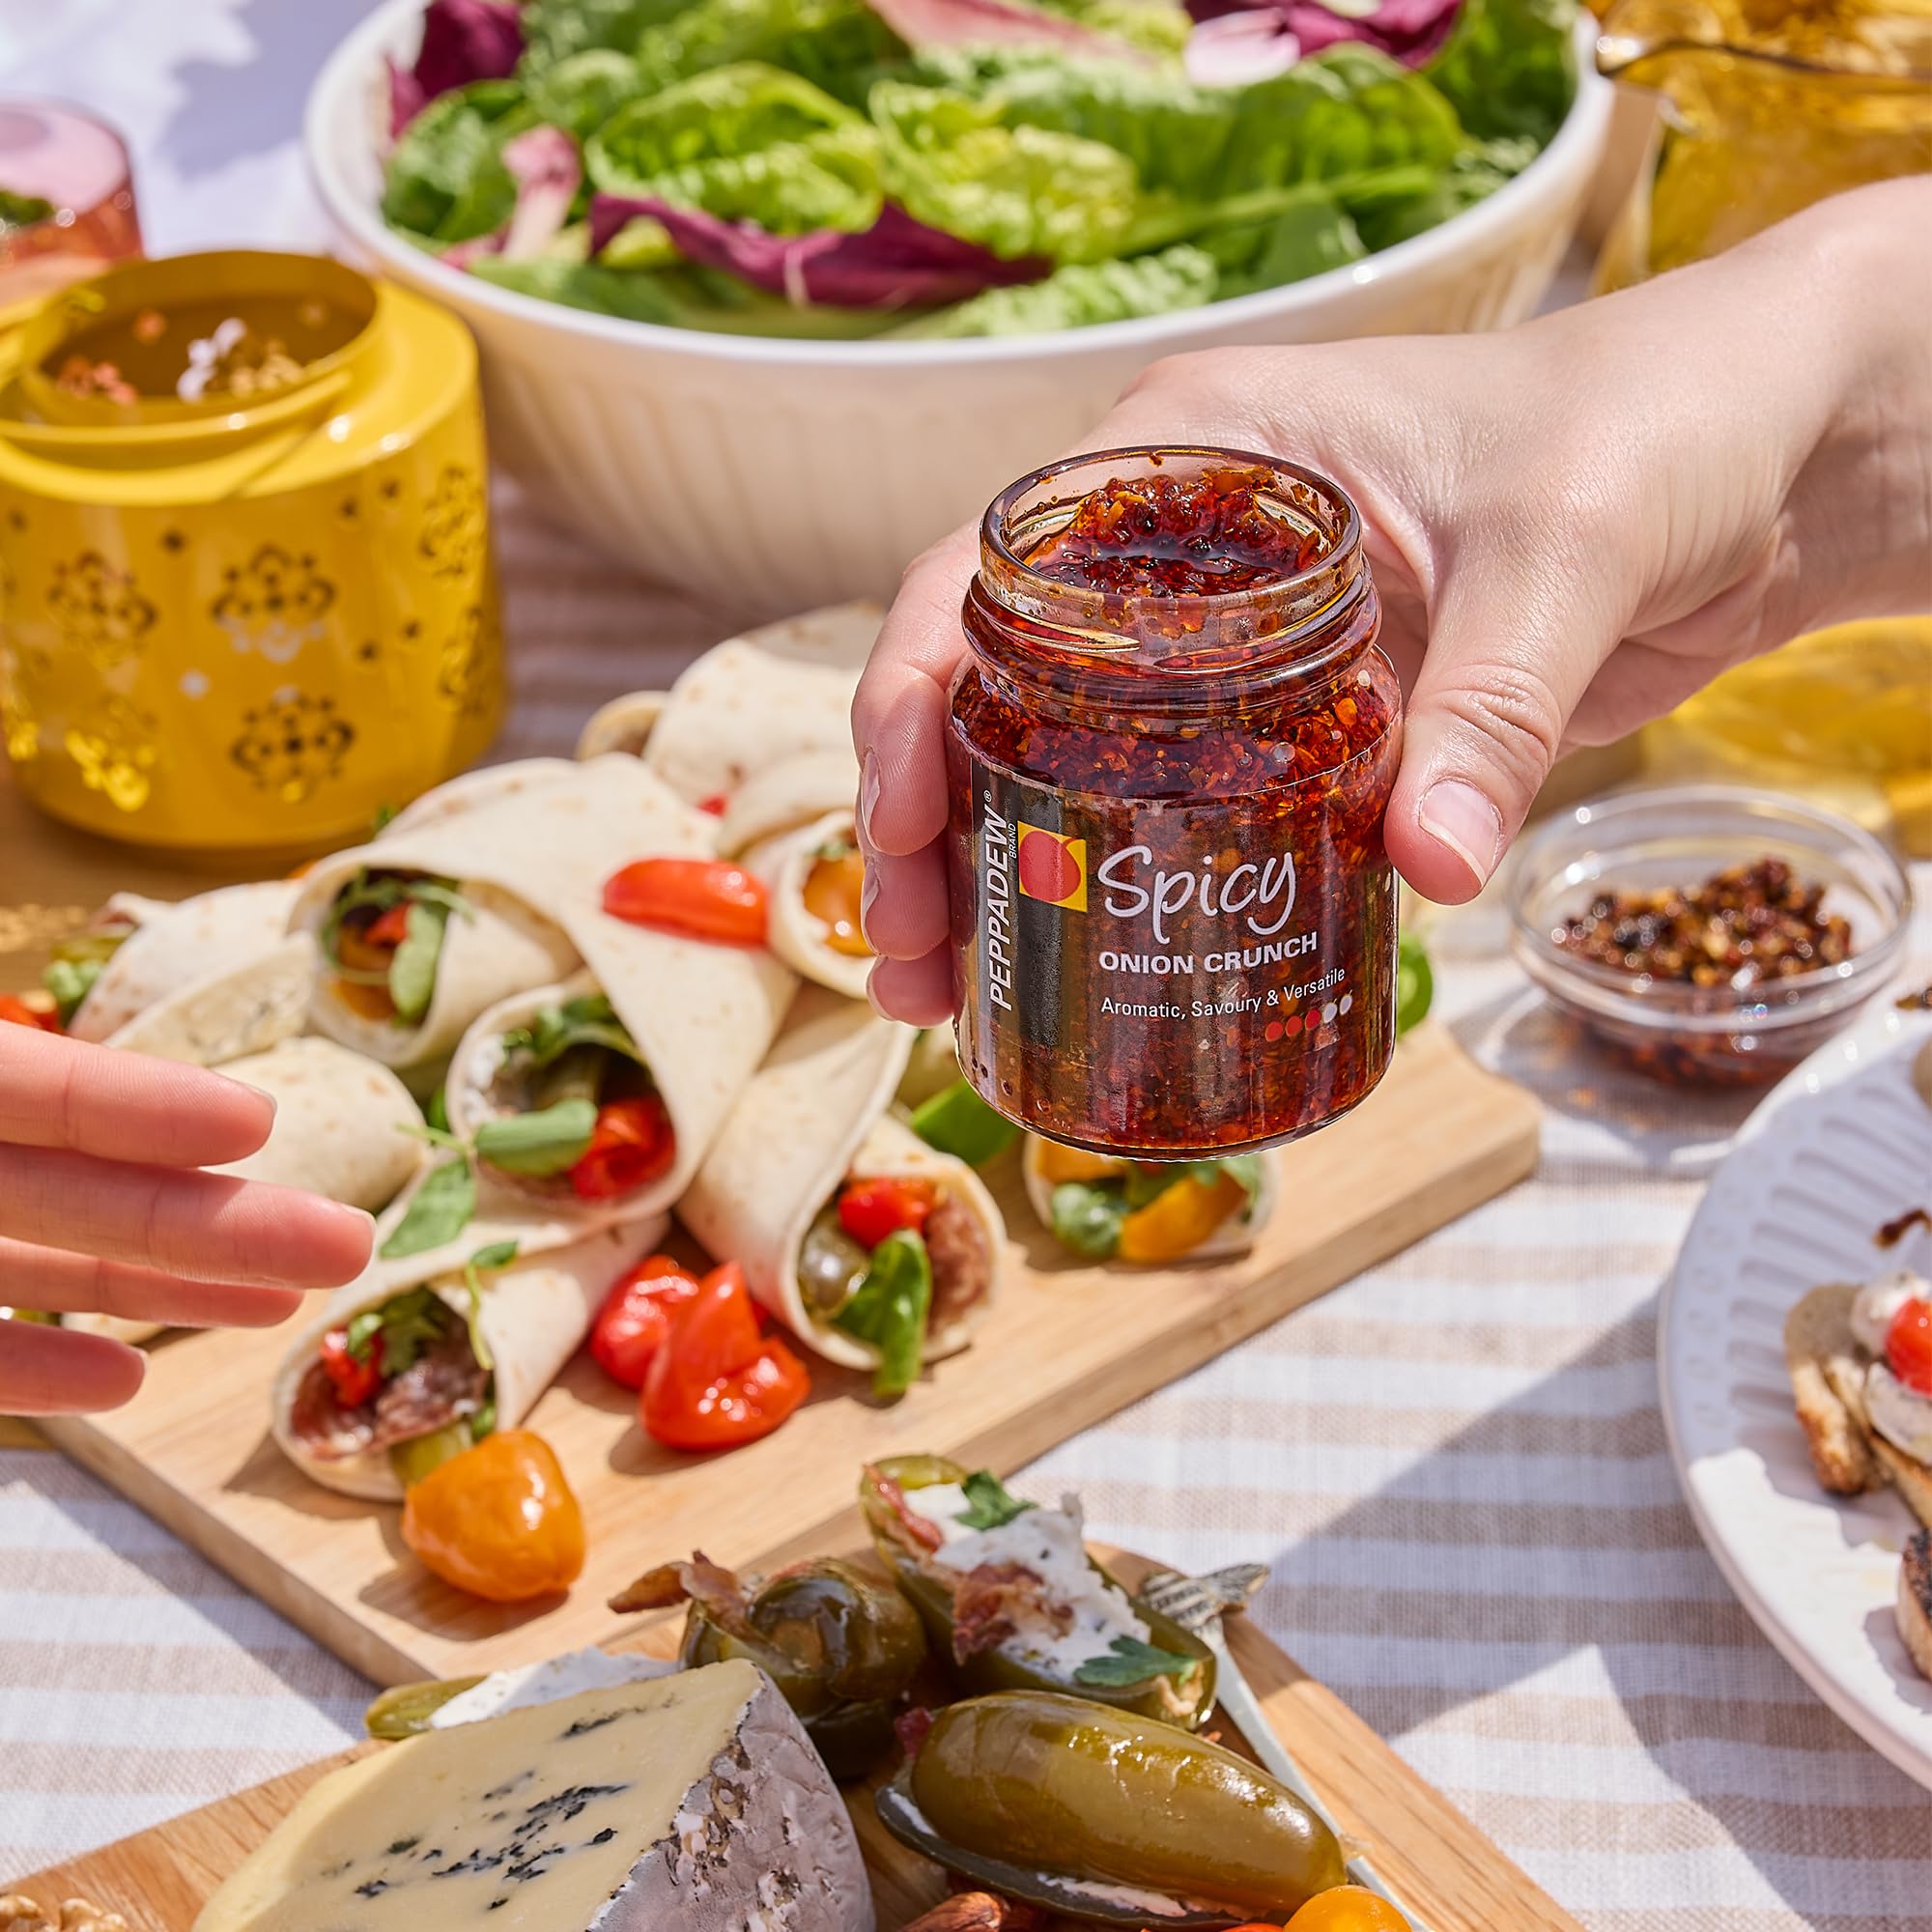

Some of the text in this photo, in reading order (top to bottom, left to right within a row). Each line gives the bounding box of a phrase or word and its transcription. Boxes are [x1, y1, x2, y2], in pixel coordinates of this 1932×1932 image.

[1008, 823, 1017, 859] BRAND
[1097, 844, 1296, 945] Spicy
[1098, 931, 1318, 975] ONION CRUNCH
[1100, 967, 1346, 1020] Aromatic, Savoury & Versatile
